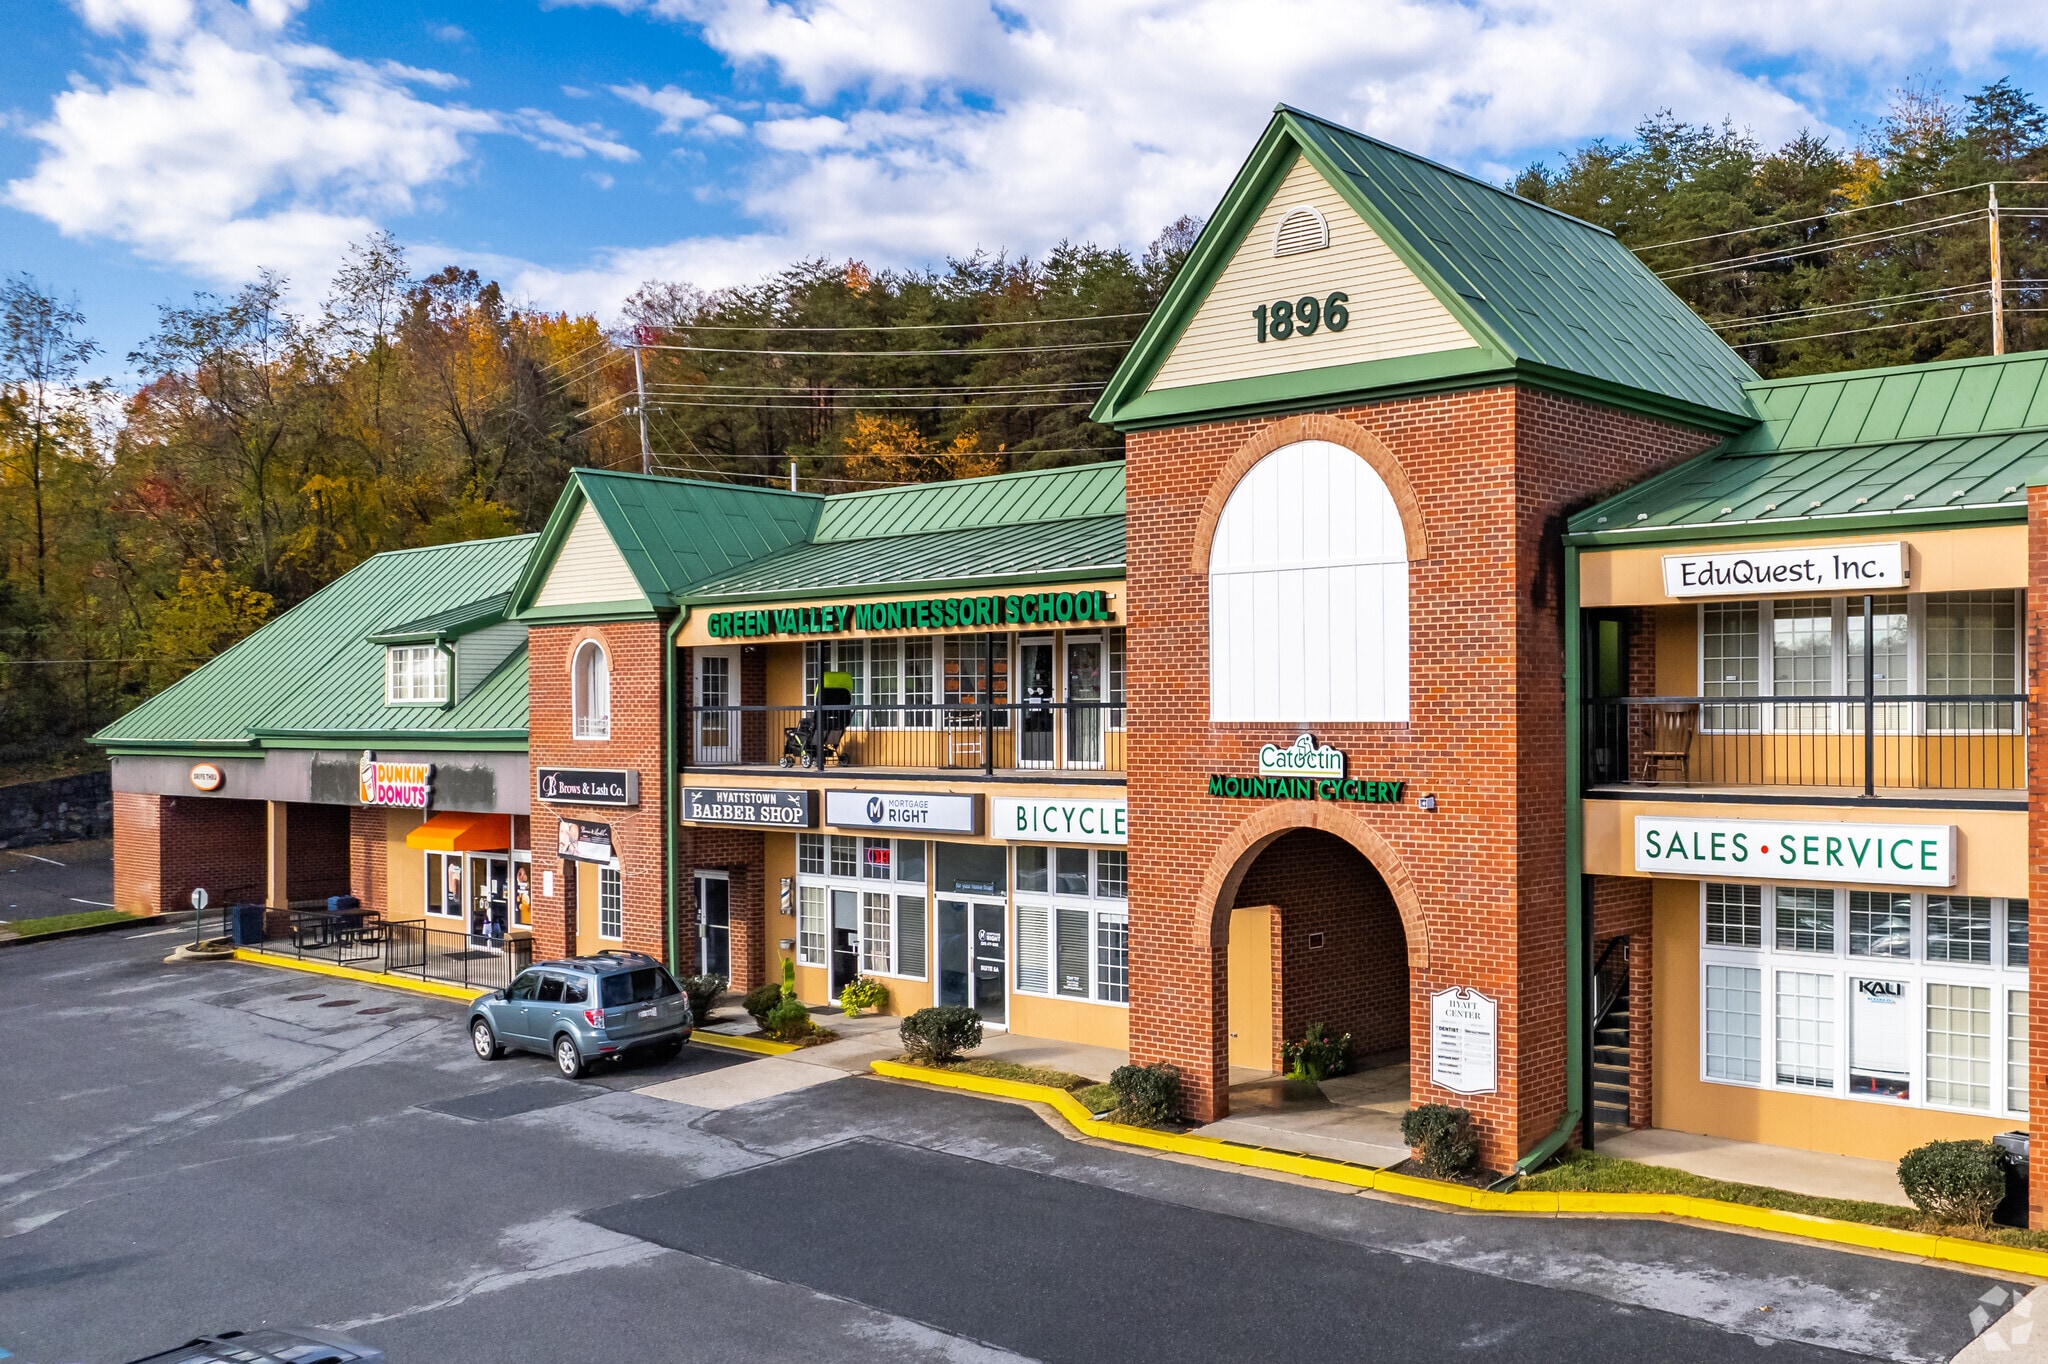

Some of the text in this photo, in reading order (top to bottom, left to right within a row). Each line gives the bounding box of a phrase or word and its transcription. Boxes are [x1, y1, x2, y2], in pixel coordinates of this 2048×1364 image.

[1252, 291, 1349, 343] 1896
[1681, 554, 1885, 586] EduQuest, Inc.
[707, 590, 1109, 638] GREEN VALLEY MONTESSORI SCHOOL
[1261, 745, 1341, 769] Catoctin
[378, 764, 428, 784] DUNKIN'
[378, 785, 425, 806] DONUTS
[559, 781, 581, 794] Brows
[582, 782, 590, 795] &
[591, 783, 608, 796] Lash
[610, 784, 624, 797] Co.
[716, 791, 777, 804] HYATTSTOWN
[1208, 775, 1402, 802] MOUNTAIN CYCLERY
[692, 803, 803, 823] BARBER SHOP
[888, 800, 929, 809] MORTGAGE
[888, 809, 929, 823] RIGHT
[1017, 805, 1126, 835] BICYCLE
[1646, 829, 1938, 871] SALES SERVICE
[1859, 980, 1901, 997] KALI
[1445, 1009, 1481, 1020] CENTER
[1449, 999, 1479, 1010] HYATT
[1438, 1025, 1459, 1033] DENTIST
